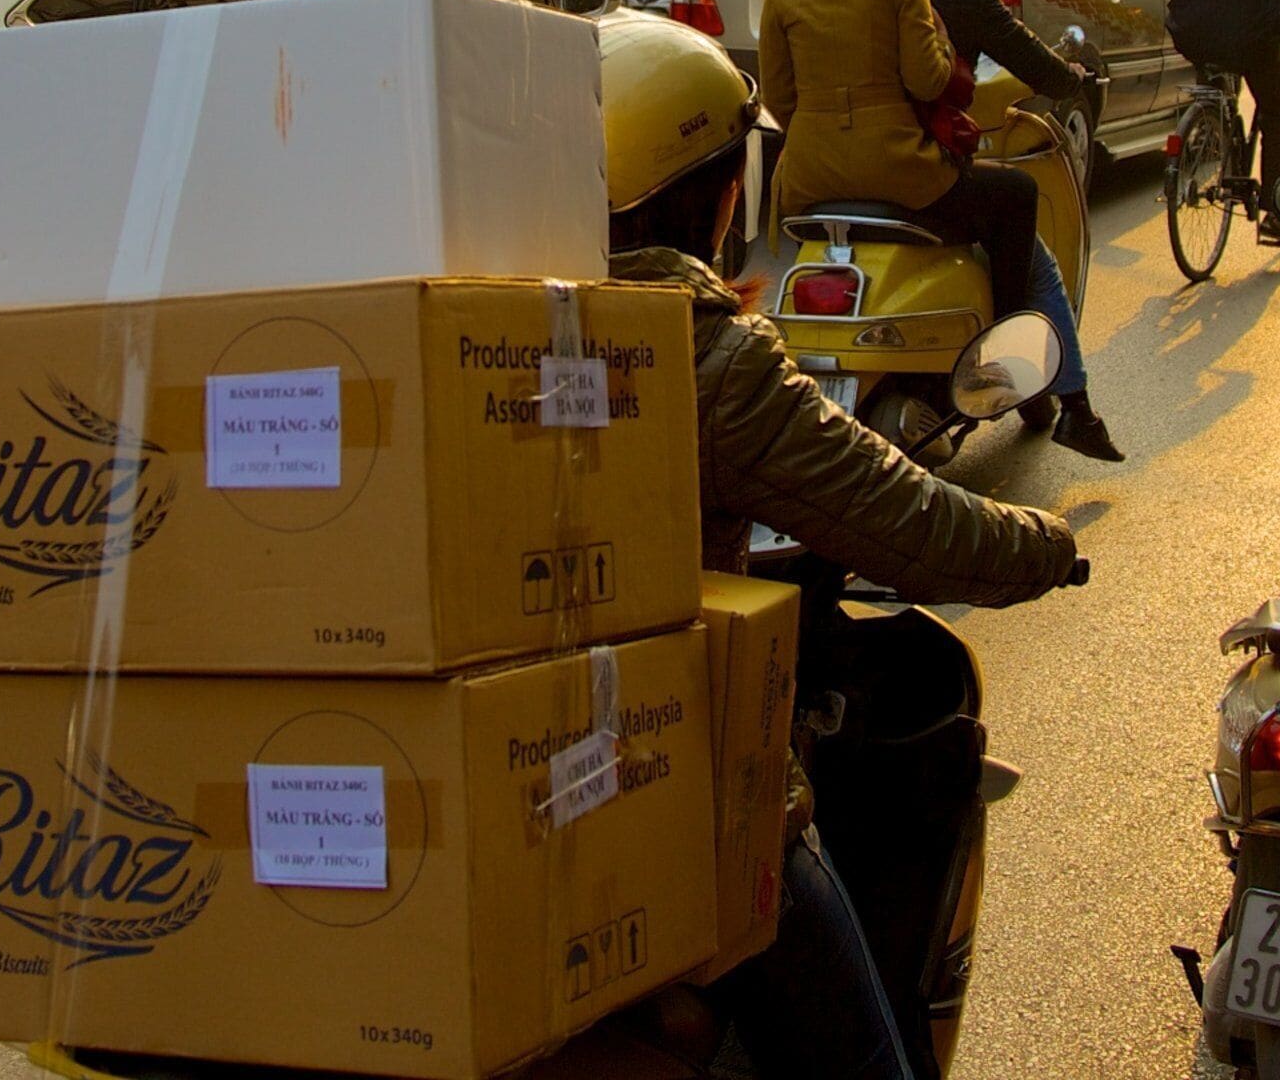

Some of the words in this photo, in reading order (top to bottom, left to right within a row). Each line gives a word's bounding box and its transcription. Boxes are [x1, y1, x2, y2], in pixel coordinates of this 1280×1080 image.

[459, 336, 553, 369] Produced
[582, 338, 655, 377] Malaysia
[230, 387, 260, 400] BÁNH
[224, 416, 255, 434] MÀU
[320, 414, 339, 432] SỐ
[619, 695, 683, 744] Malaysia
[619, 749, 671, 792] iscuits
[266, 807, 300, 825] MÀU
[364, 810, 384, 827] SỐ
[360, 1025, 433, 1050] 10x340g
